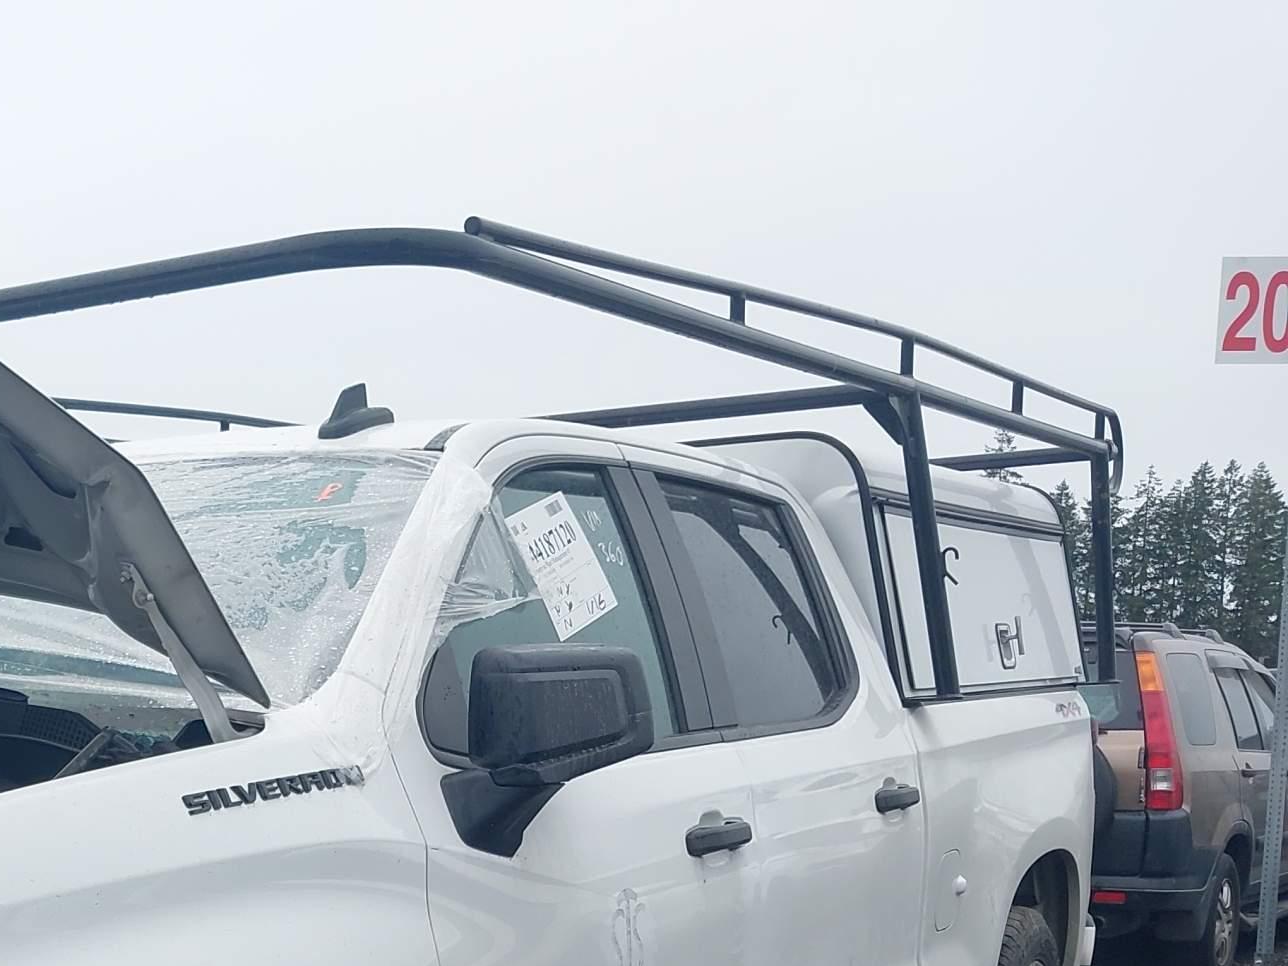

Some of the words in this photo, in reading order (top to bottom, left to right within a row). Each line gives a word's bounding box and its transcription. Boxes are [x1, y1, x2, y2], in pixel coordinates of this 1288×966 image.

[1221, 271, 1288, 353] 20
[528, 521, 576, 562] 44187120
[598, 541, 624, 566] 360
